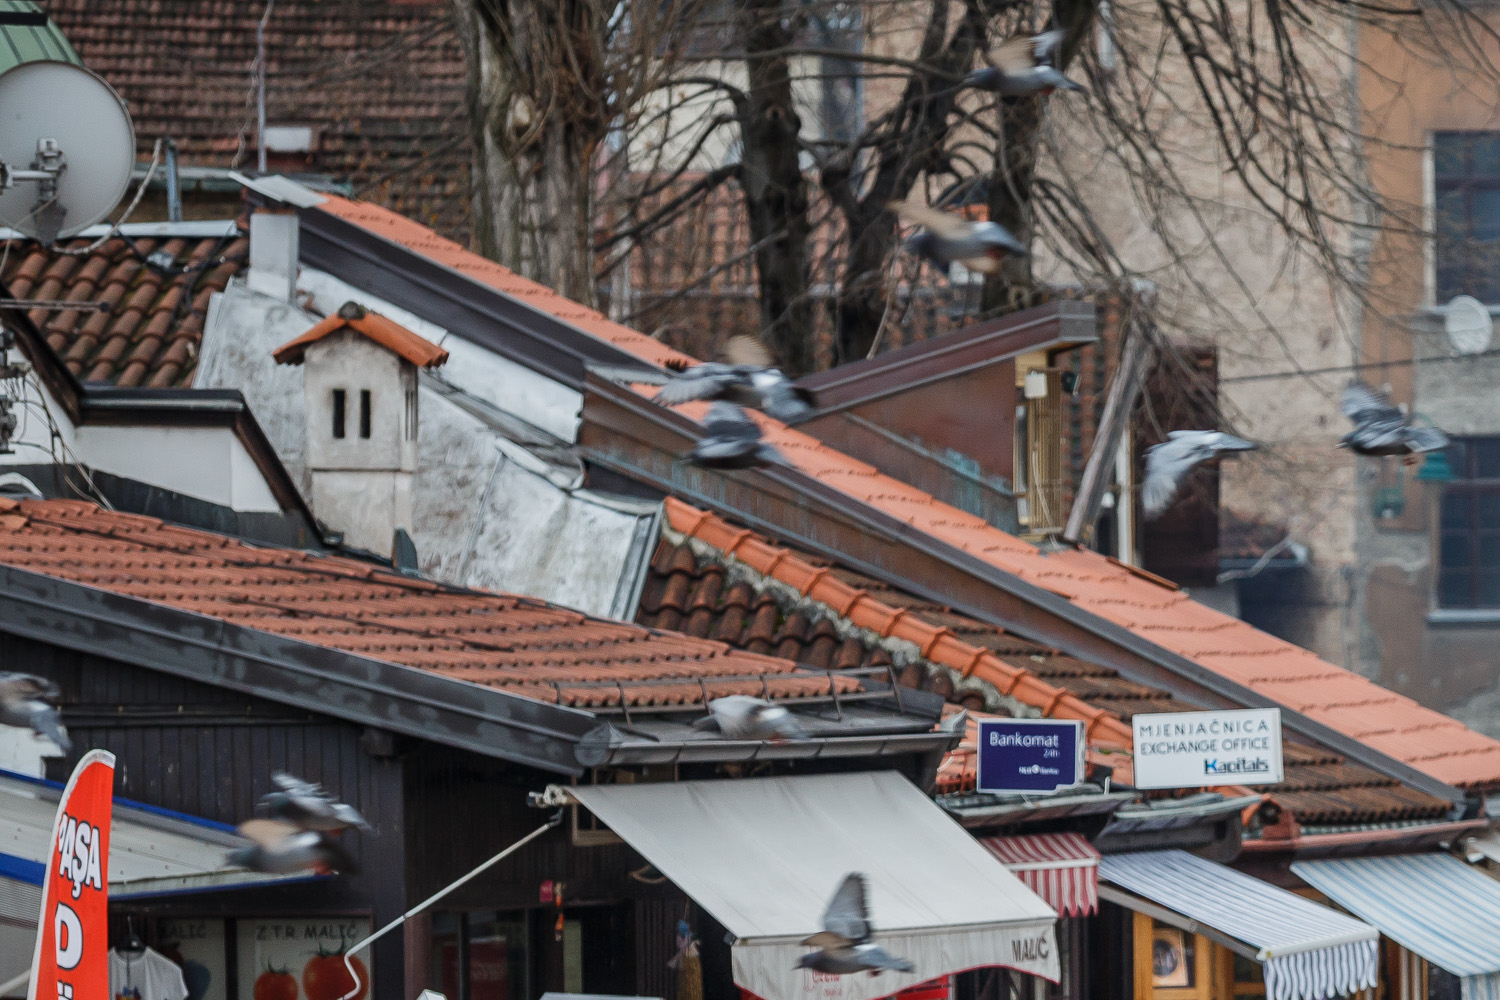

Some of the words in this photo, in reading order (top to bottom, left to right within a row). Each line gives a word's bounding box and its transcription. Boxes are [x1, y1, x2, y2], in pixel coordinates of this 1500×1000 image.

[1139, 718, 1270, 738] MJENJAČNICA
[989, 731, 1060, 748] Bankomat
[1140, 740, 1217, 756] EXCHANGE
[1221, 736, 1270, 751] OFFICE
[1203, 756, 1270, 775] Kapitals
